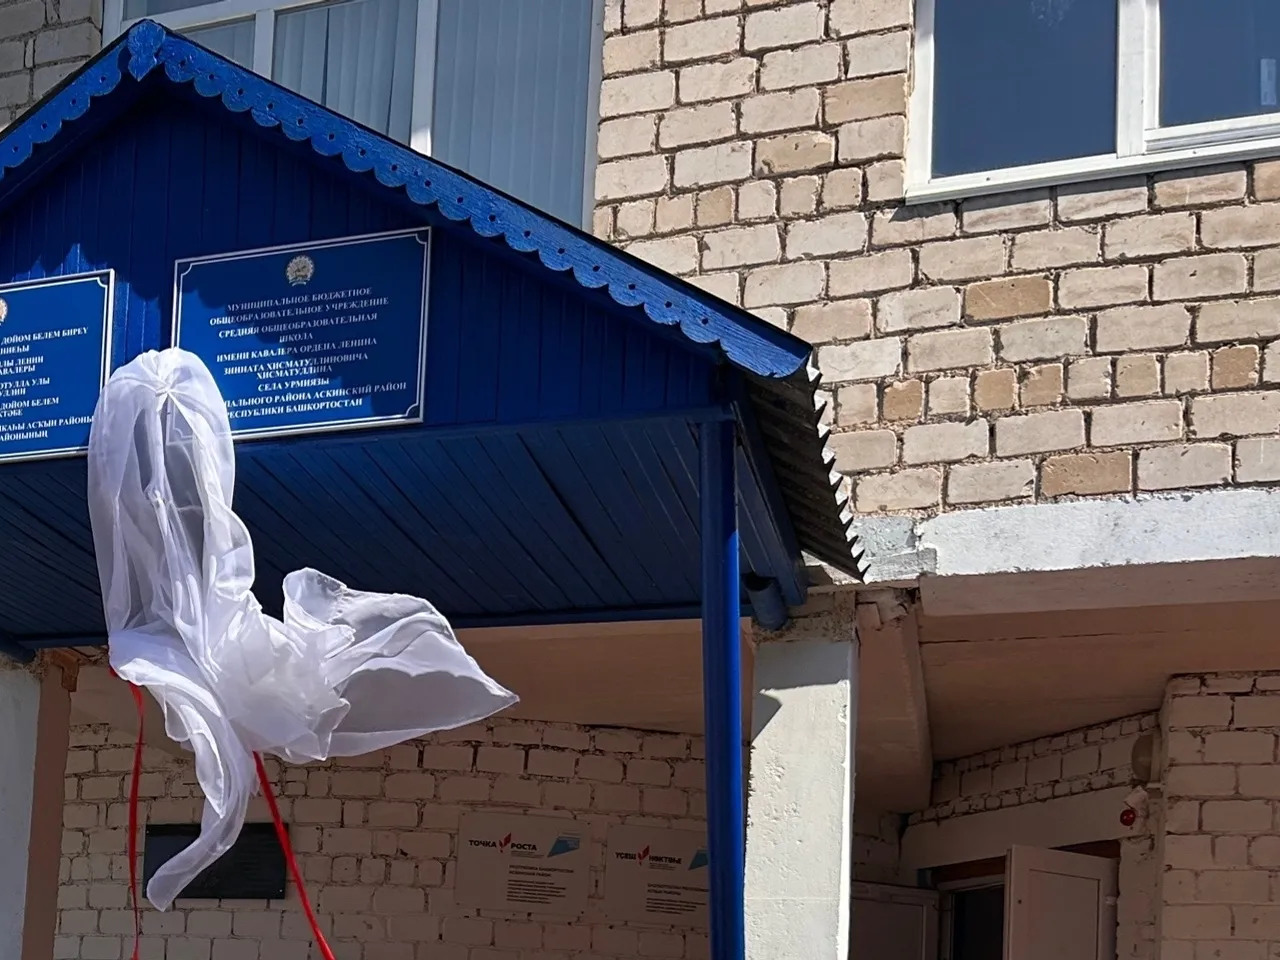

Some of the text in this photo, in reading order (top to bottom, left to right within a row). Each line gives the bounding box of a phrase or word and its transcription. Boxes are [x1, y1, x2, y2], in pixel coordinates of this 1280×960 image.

[228, 287, 372, 312] МУНИЦИПАЛЬНОЕ БЮДЖЕТНОЕ
[210, 296, 390, 325] ОБЩЕОБРАЗОВАТЕЛЬНОЕ УЧРЕЖДЕНИЕ
[218, 313, 378, 338] СРЕДНЯЯ ОБЩЕОБРАЗОВАТЕЛЬНАЯ
[1, 334, 31, 346] ДОЙОМ
[32, 331, 61, 340] БЕЛЕМ
[279, 332, 314, 343] ШКОЛА
[216, 338, 378, 362] ИМЕНИ КАВАЛЕРА ОРДЕНА ЛЕНИНА
[16, 356, 44, 366] ЛЕНИН
[224, 353, 368, 375] ЗИННАТА ХИСМАТУЛЛИНОВИЧА
[256, 365, 333, 380] ХИСМАТУЛЛИНА
[32, 377, 50, 387] УЛЫ
[258, 378, 330, 392] СЕЛА УРМИЯЗЫ
[274, 392, 312, 403] РАЙОНА
[313, 385, 372, 400] АСКИНСКИЙ
[374, 382, 407, 393] РАЙОН
[1, 400, 30, 412] ДОЙОМ
[31, 397, 59, 407] БЕЛЕМ
[286, 398, 363, 413] БАШКОРТОСТАН
[468, 840, 537, 851] ТОЧКА РОСТА
